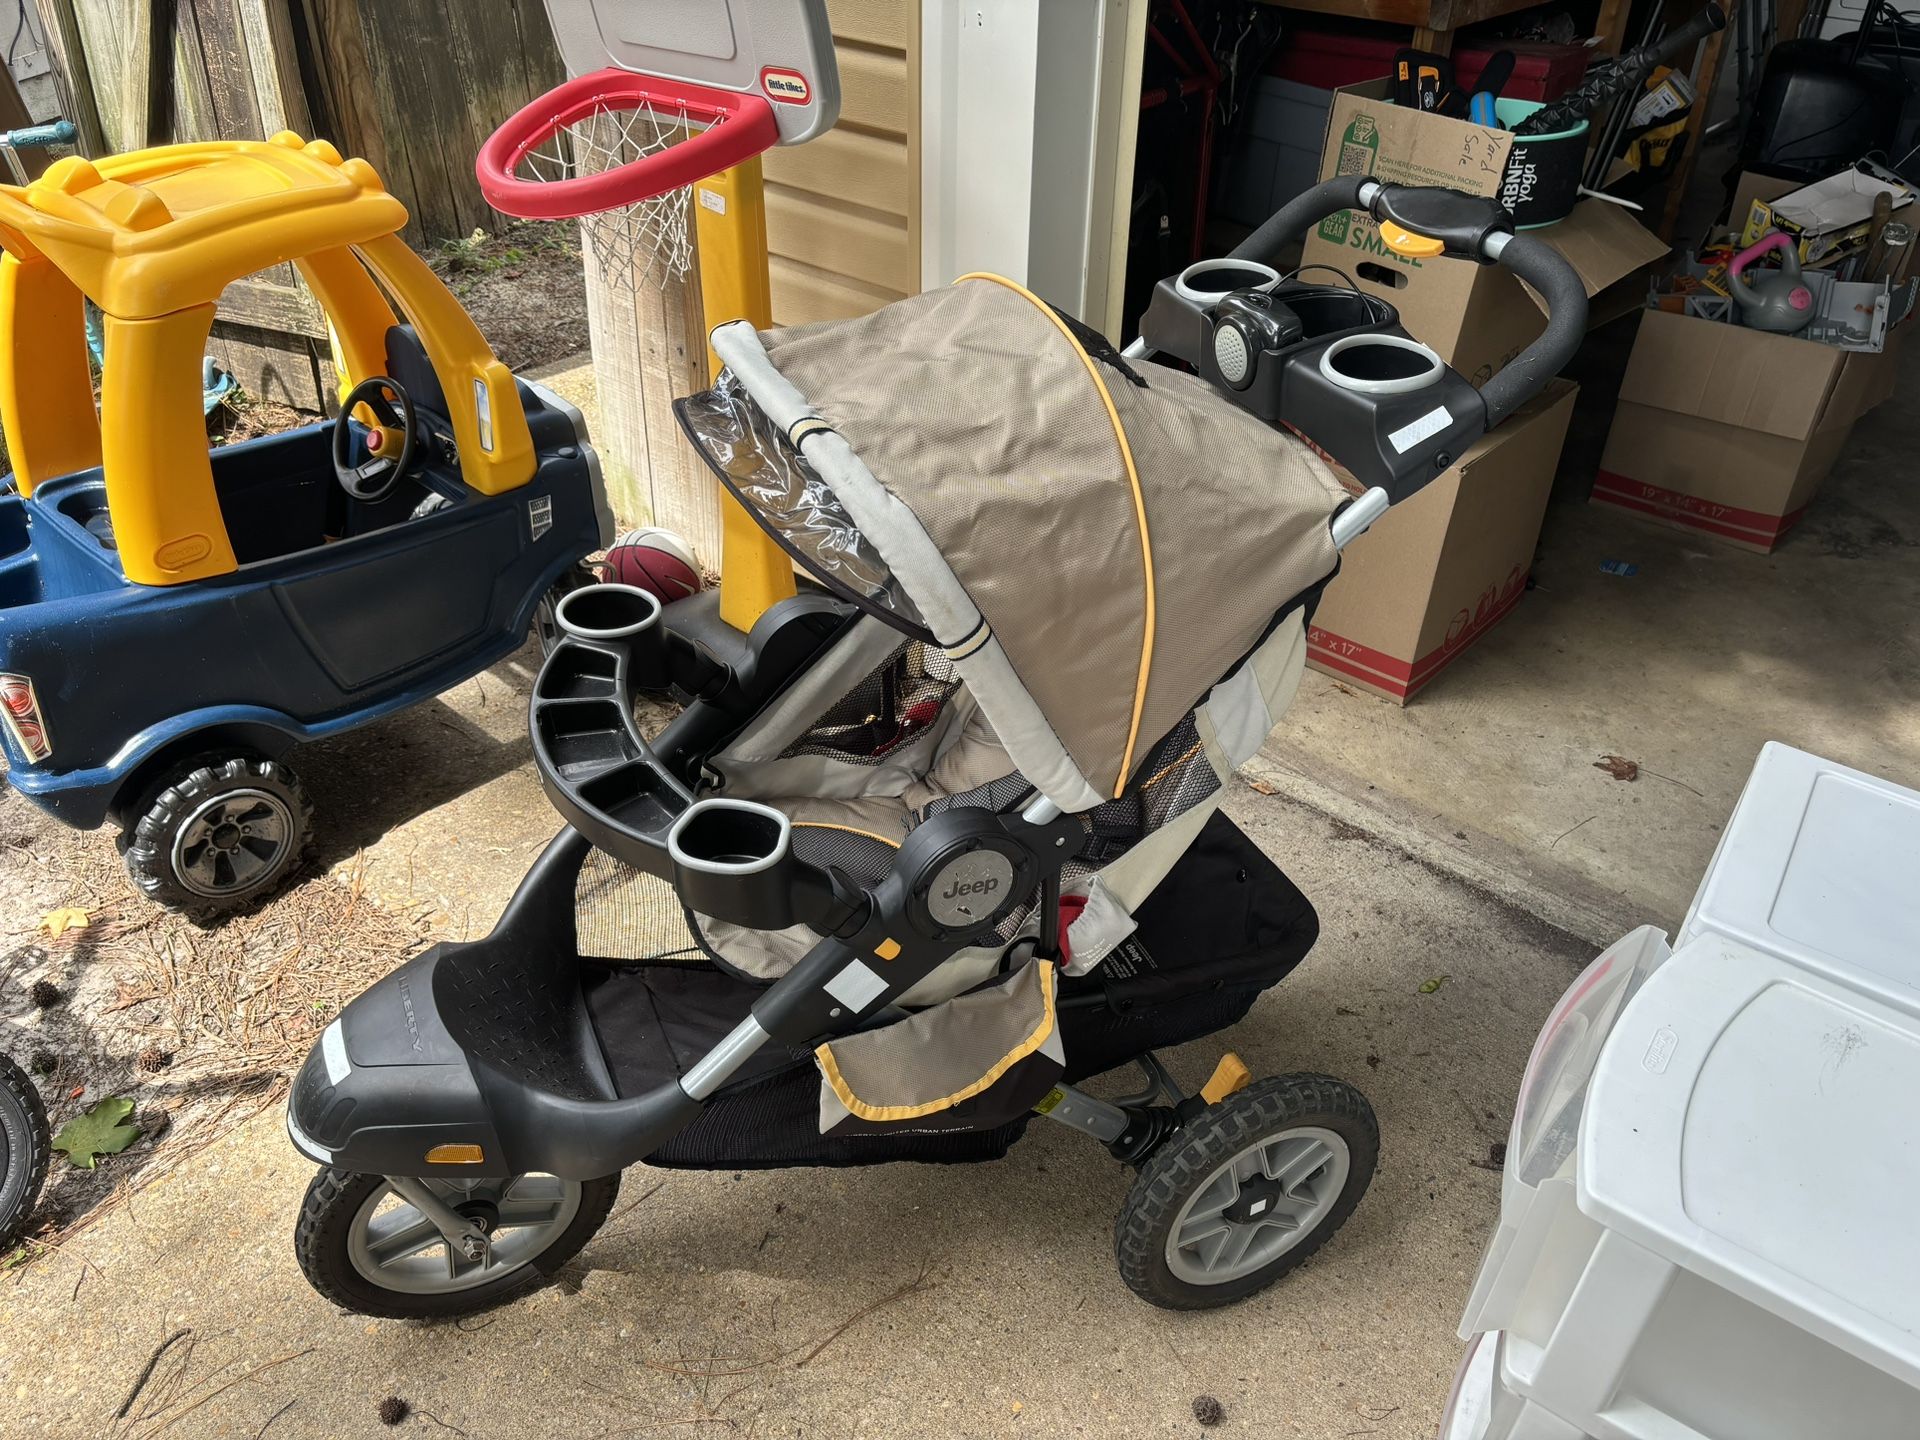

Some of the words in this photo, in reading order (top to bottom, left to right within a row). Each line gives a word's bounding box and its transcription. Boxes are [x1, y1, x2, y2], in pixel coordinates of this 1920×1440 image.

[767, 79, 785, 90] little
[785, 81, 803, 93] tikes
[1459, 135, 1479, 166] Sale
[1481, 130, 1503, 175] Yard
[1381, 166, 1406, 177] SHIPPING
[1407, 172, 1439, 186] RESOURCES
[1421, 167, 1456, 181] ADDITIONAL
[1457, 176, 1483, 188] PACKING
[1518, 163, 1537, 203] yoga
[1324, 220, 1344, 238] GEAR
[1329, 640, 1337, 650] x
[1341, 642, 1362, 655] 17"
[943, 878, 998, 899] Jeep
[941, 1125, 974, 1133] TERRAIN
